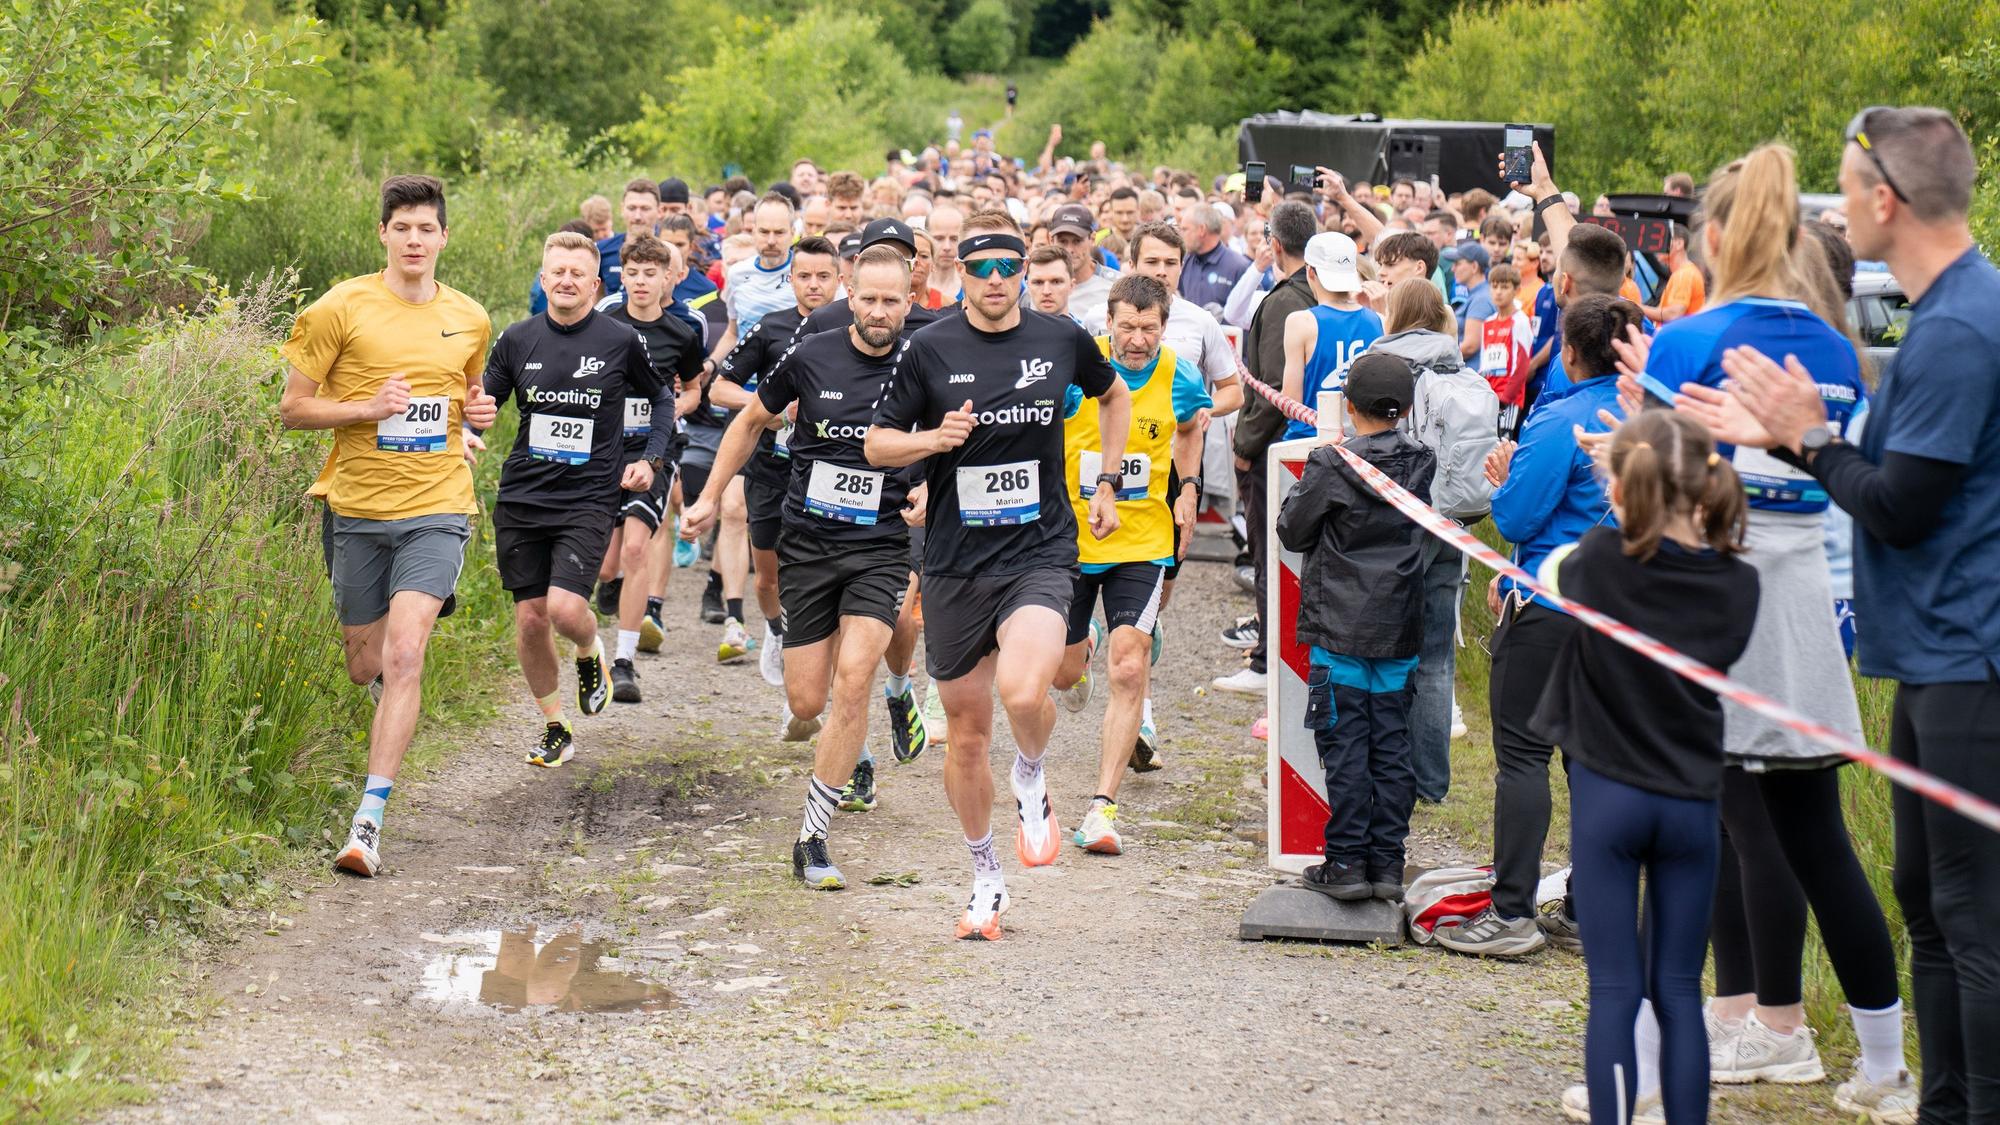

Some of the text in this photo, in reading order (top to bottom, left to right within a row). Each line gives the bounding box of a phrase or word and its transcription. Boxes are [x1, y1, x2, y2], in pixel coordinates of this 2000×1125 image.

[1583, 217, 1666, 252] :13
[949, 374, 975, 384] JAKO
[820, 390, 843, 400] JAKO
[406, 402, 442, 422] 260
[632, 403, 650, 416] 19
[551, 421, 584, 439] 292
[815, 419, 869, 439] Xcoa
[557, 442, 575, 450] Georg
[834, 473, 873, 495] 285
[985, 469, 1029, 493] 286
[840, 497, 863, 507] Michel
[996, 498, 1024, 506] Marian
